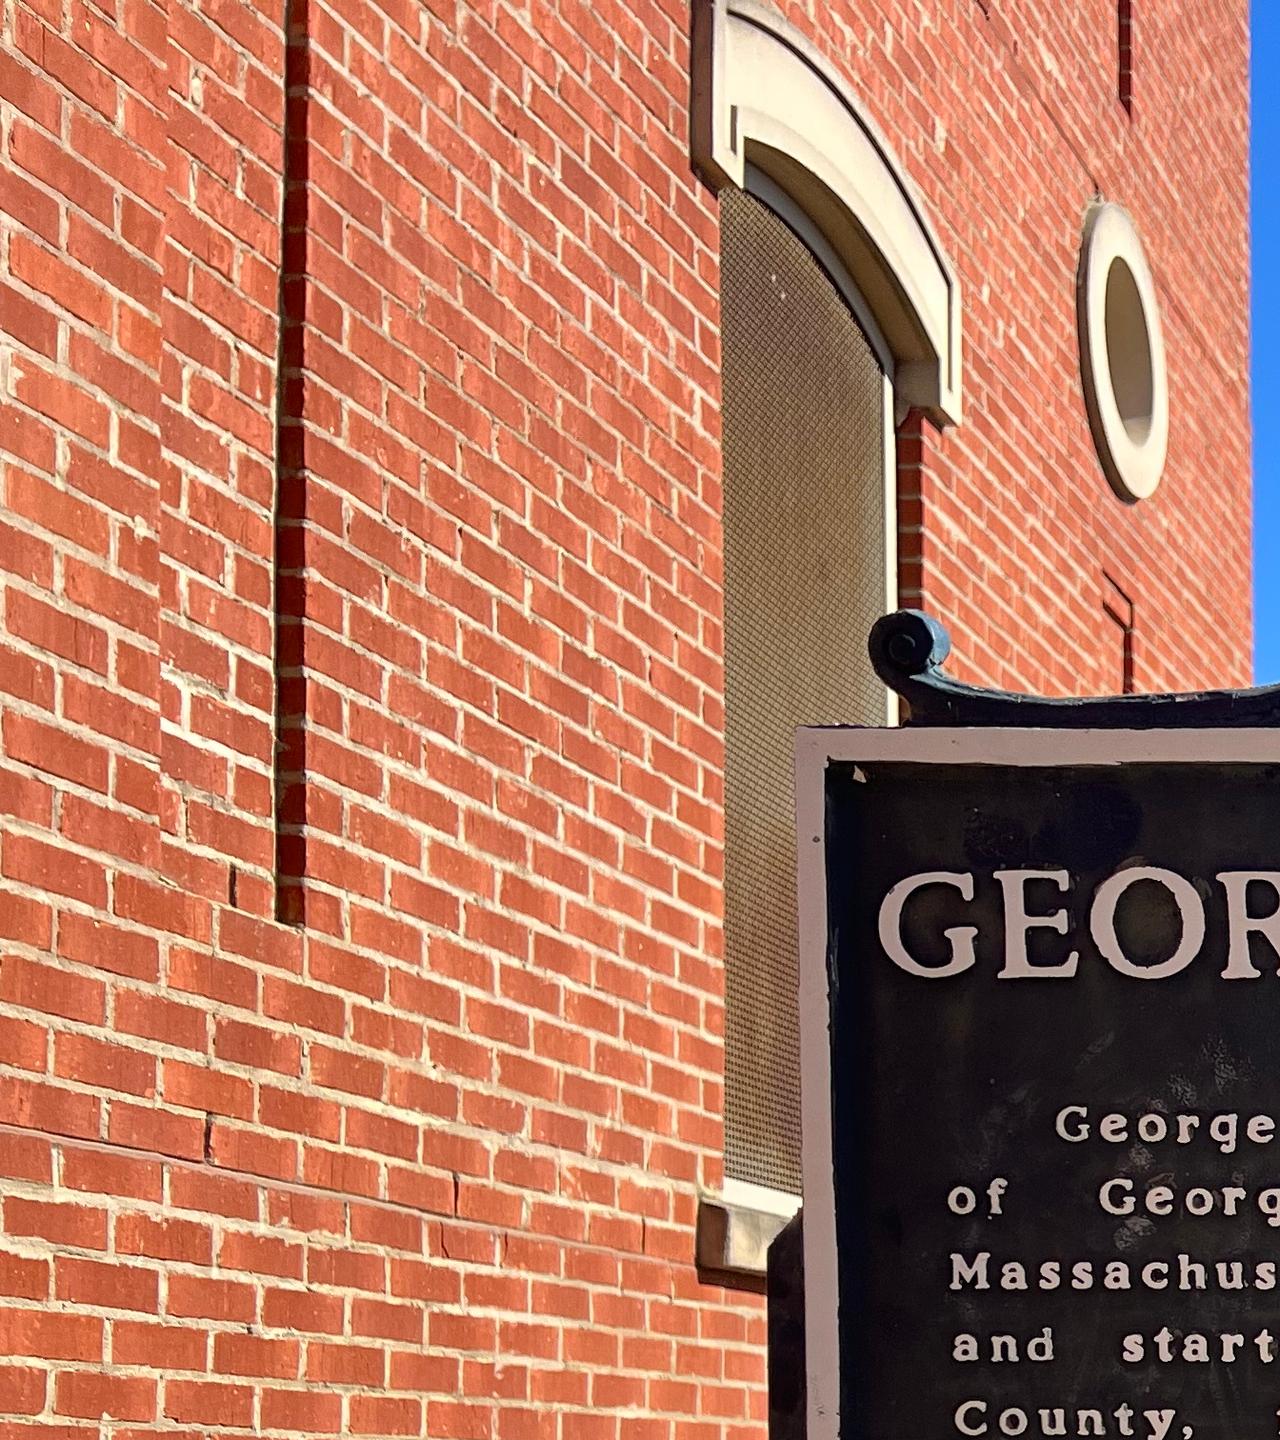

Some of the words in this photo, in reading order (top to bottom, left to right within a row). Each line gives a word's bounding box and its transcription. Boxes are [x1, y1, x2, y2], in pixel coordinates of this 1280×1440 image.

[1055, 1105, 1276, 1154] George
[947, 1177, 1008, 1215] of
[952, 1327, 1054, 1363] and
